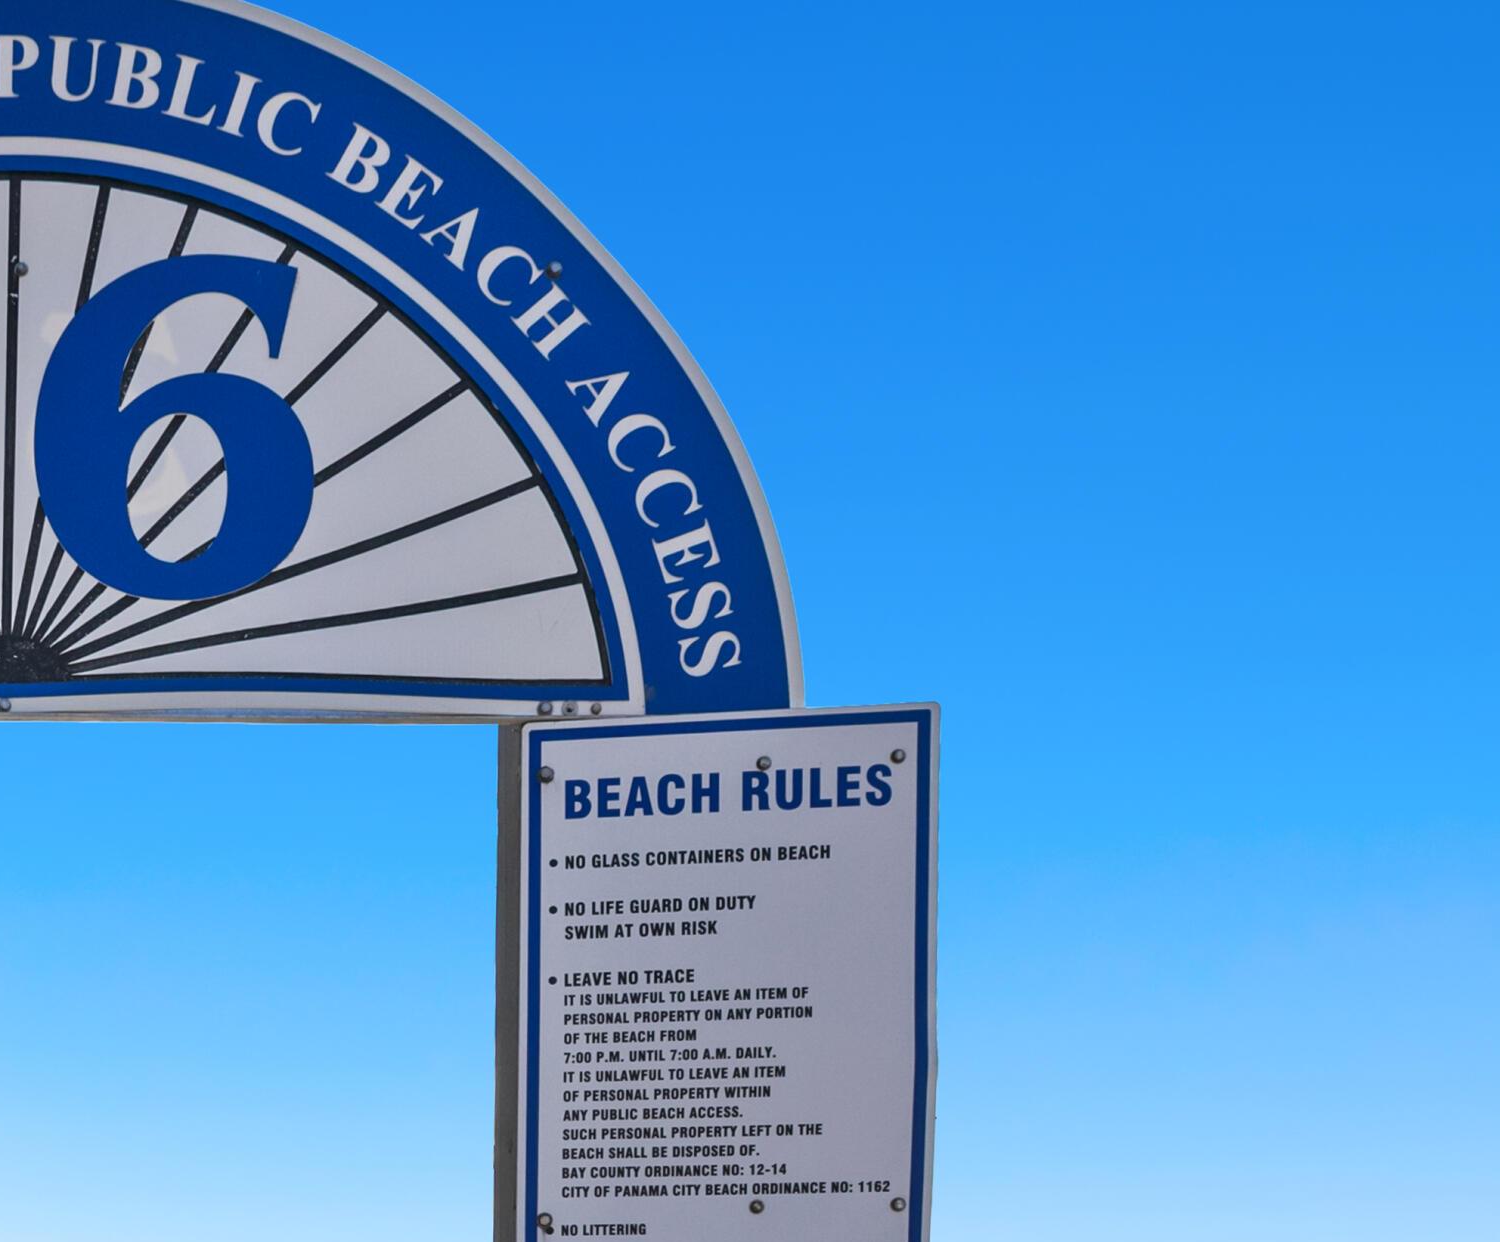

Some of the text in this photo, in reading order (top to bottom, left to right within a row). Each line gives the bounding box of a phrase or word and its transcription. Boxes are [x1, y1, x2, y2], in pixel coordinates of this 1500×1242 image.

[325, 122, 591, 360] BEACH
[565, 371, 742, 677] ACCESS
[564, 763, 891, 819] BEACH RULES
[564, 844, 830, 869] NO GLASS CONTAINERS ON BEACH
[564, 894, 756, 916] NO LIFE GUARD ON DUTY
[564, 919, 717, 940] SWIM AT OWN RISK
[563, 968, 694, 987] LEAVE NO TRACE
[563, 1045, 776, 1064] 7:00 P.M. UNTIL 7:00 A.M. DAILY.
[560, 1222, 646, 1236] NO LITTERING
